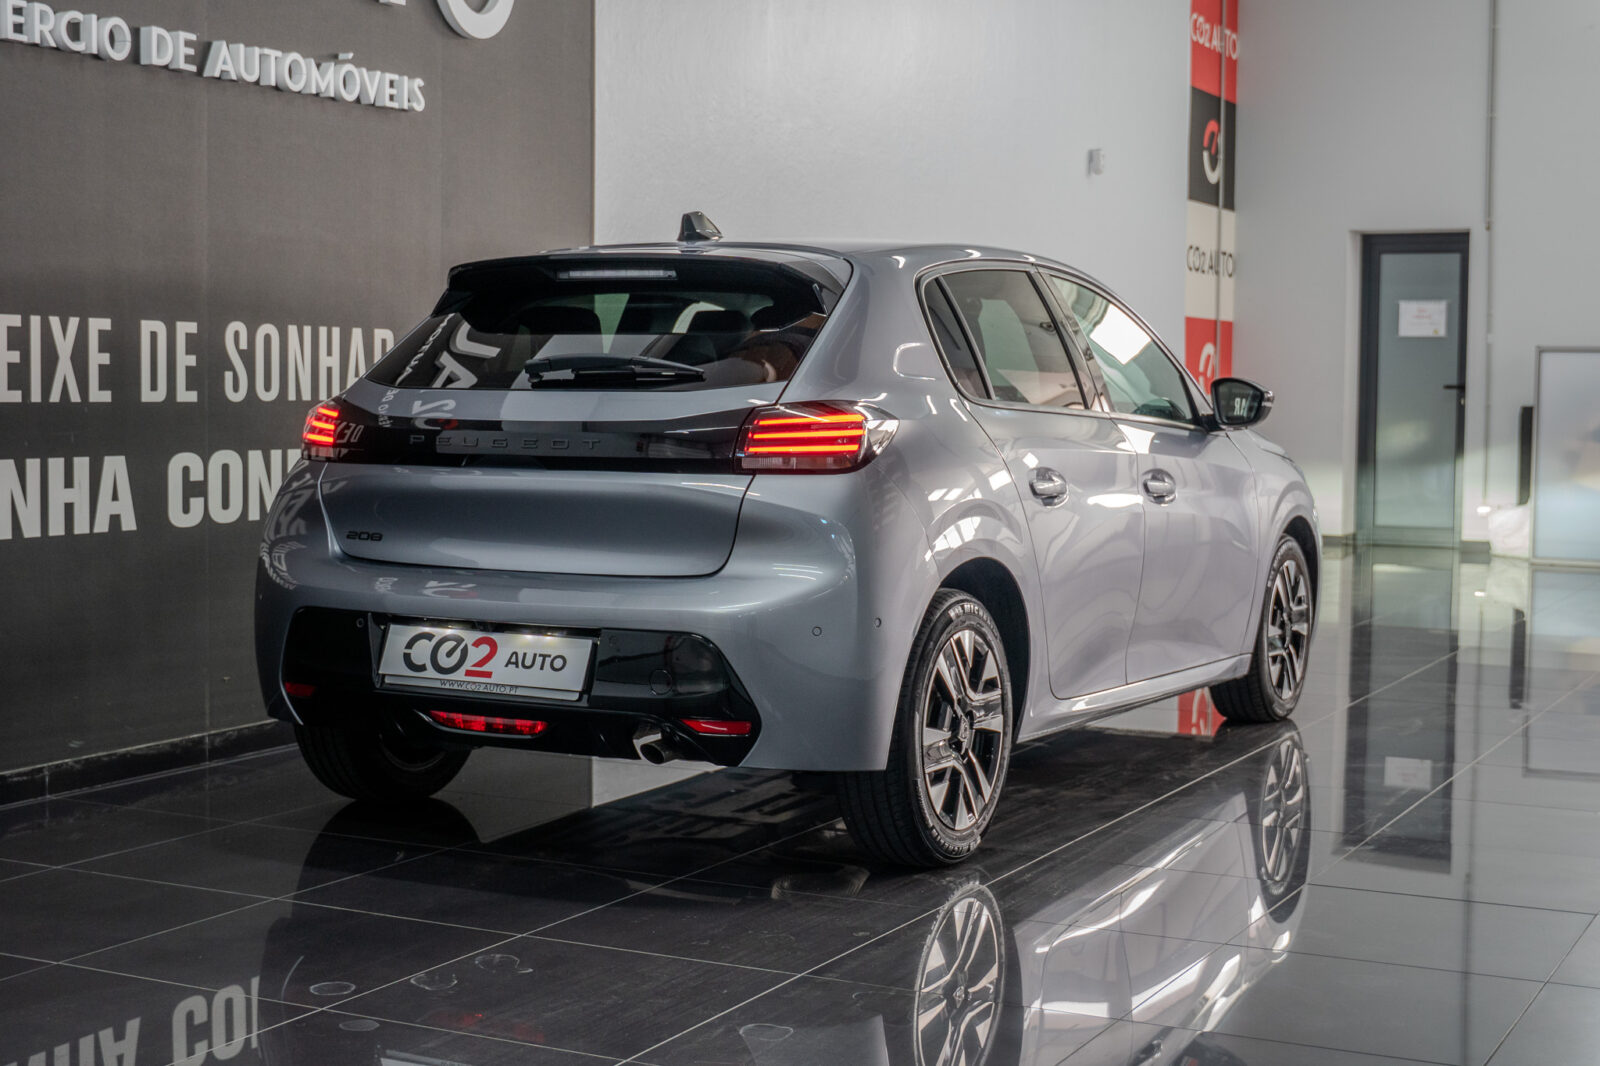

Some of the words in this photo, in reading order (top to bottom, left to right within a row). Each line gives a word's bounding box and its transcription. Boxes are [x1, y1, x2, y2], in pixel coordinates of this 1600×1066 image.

[140, 26, 198, 72] DE
[203, 40, 425, 112] AUTOMÓVEIS
[0, 313, 112, 403] EIXE
[140, 319, 198, 403] DE
[410, 434, 600, 450] PEUGEOT
[167, 449, 301, 528] CON
[346, 530, 383, 541] 208
[403, 631, 498, 679] CO2
[504, 650, 568, 673] AUTO
